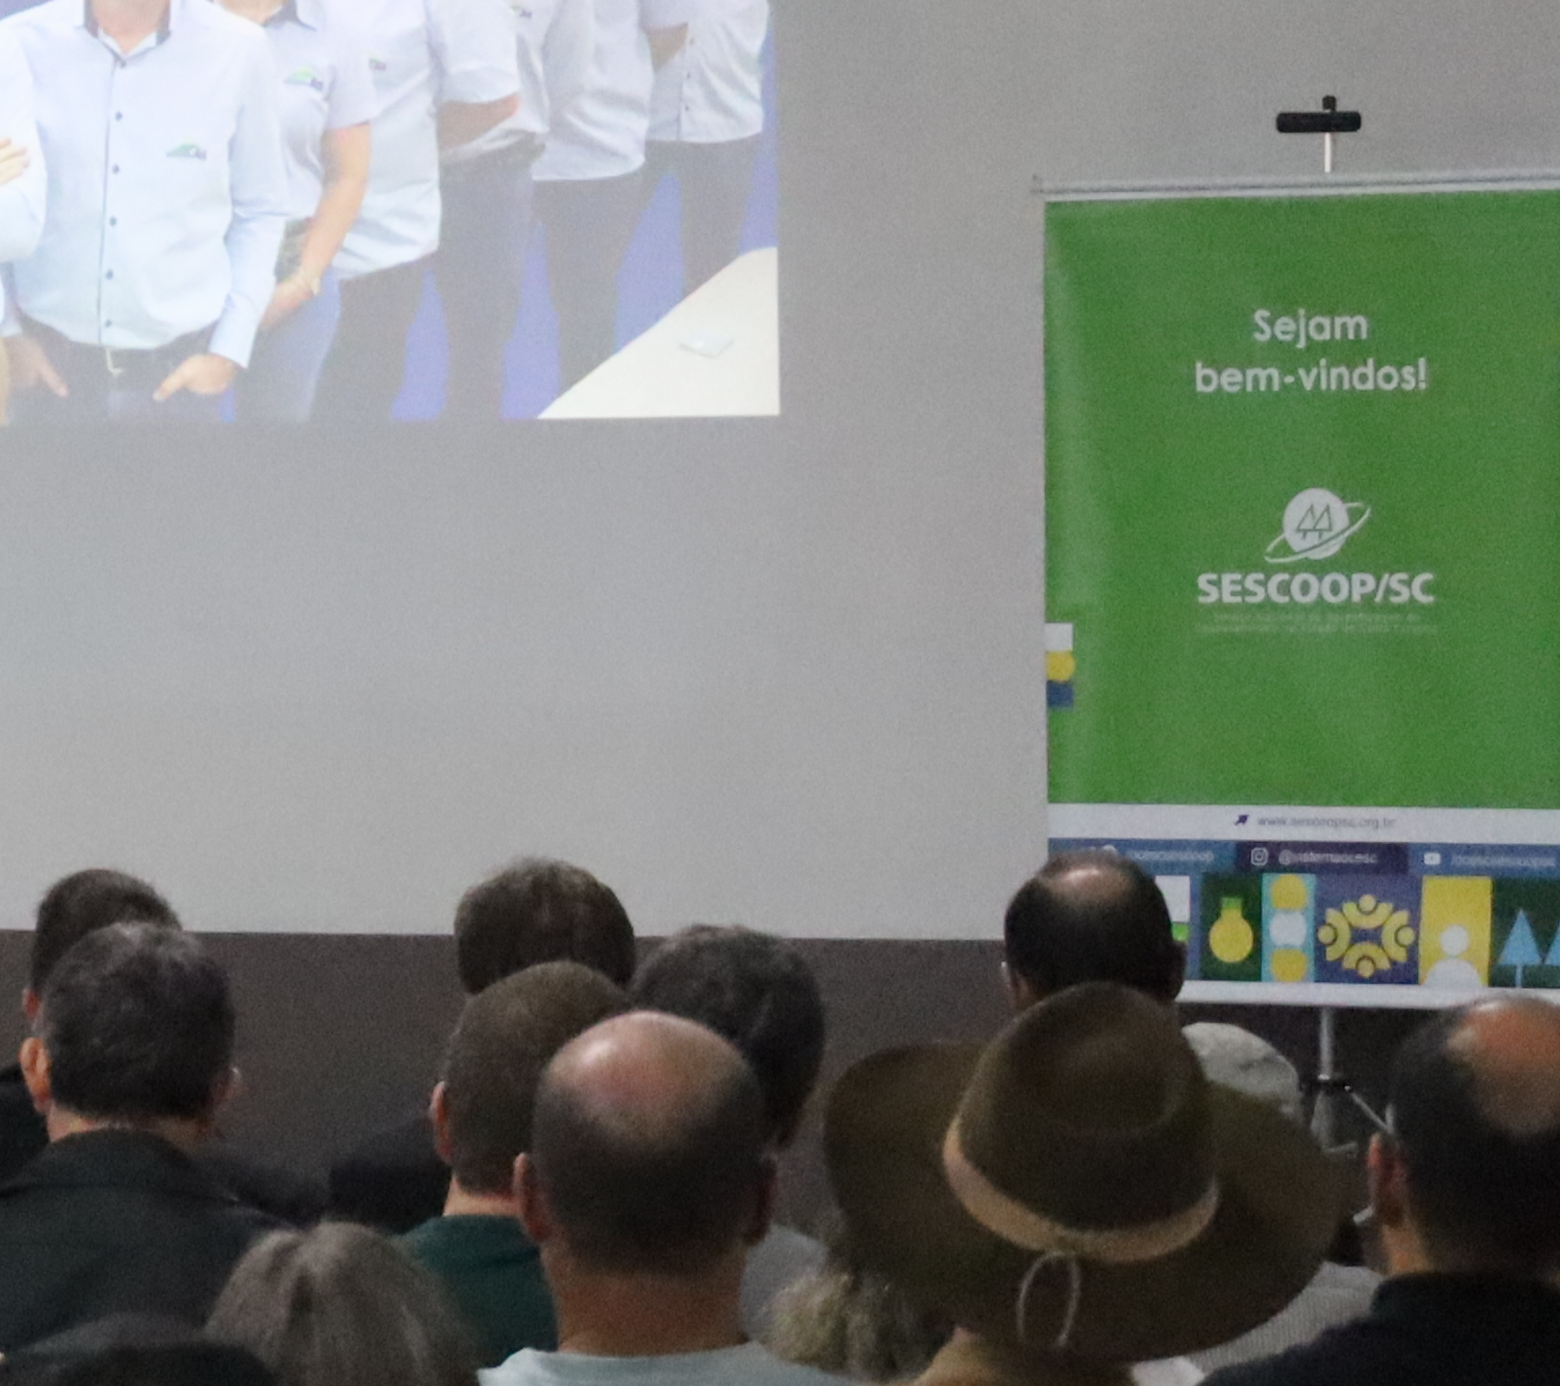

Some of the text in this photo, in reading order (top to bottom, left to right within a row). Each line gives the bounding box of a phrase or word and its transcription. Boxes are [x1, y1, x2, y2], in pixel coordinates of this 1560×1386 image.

[1252, 307, 1370, 349] Sejam
[1193, 355, 1429, 395] bem-vindos!
[1196, 571, 1436, 604] SESCOOP/SC
